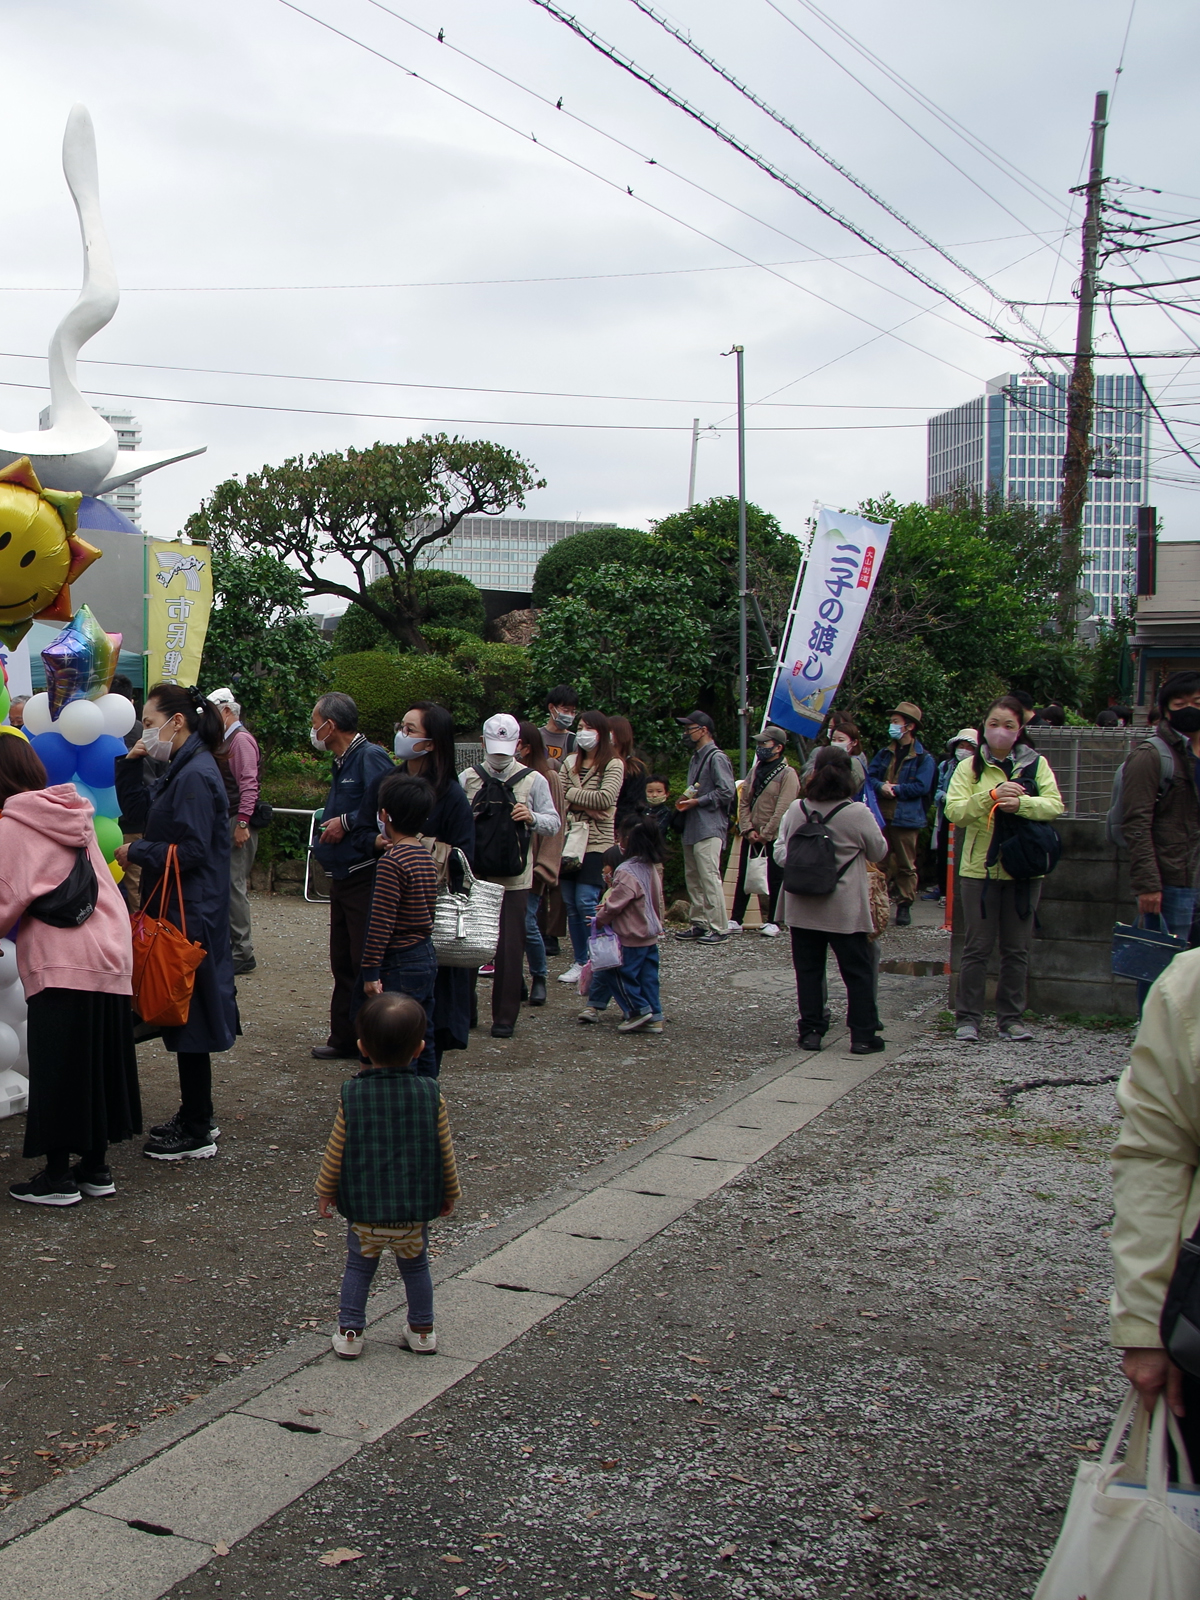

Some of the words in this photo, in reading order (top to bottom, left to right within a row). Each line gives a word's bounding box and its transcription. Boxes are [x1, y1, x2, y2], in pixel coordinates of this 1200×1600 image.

[860, 551, 874, 583] 大山街道
[802, 543, 861, 681] 二子の渡し
